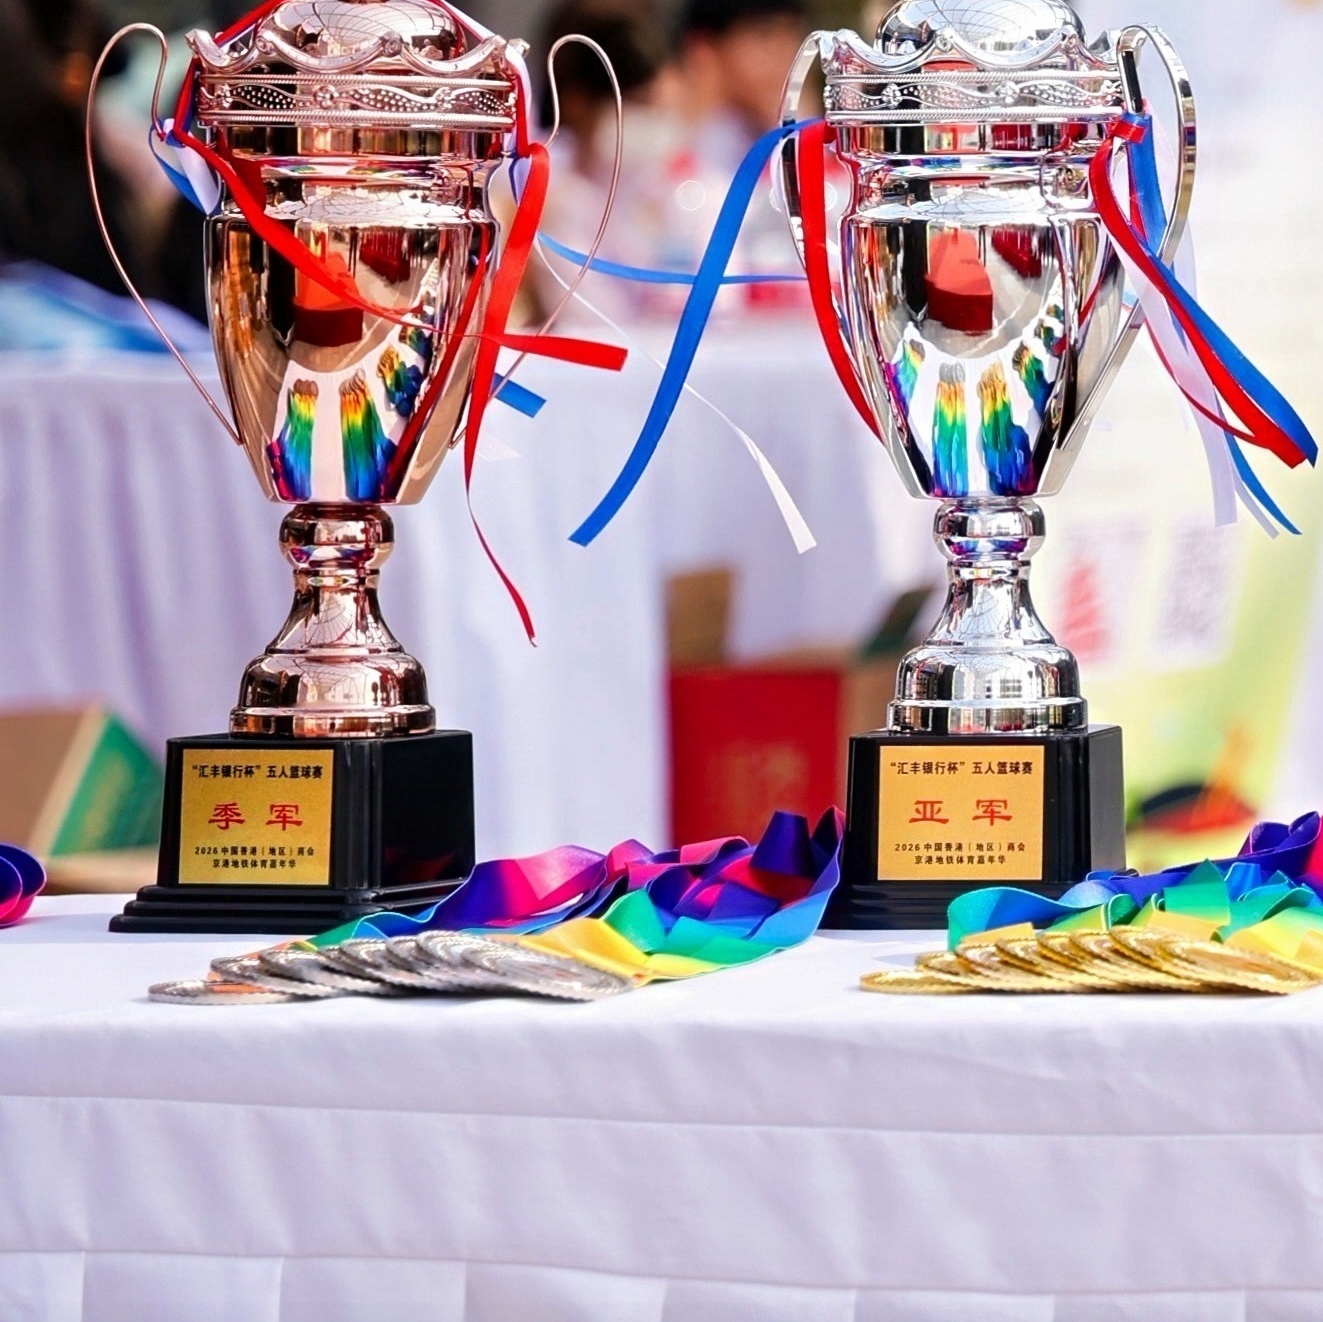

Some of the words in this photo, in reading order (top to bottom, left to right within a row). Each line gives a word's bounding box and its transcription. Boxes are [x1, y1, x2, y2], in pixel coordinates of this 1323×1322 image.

[207, 801, 304, 832] 季军
[908, 799, 1013, 827] 亚军
[212, 858, 297, 870] 京港地铁体育嘉年华
[914, 854, 1006, 865] 京港地铁体育嘉年华
